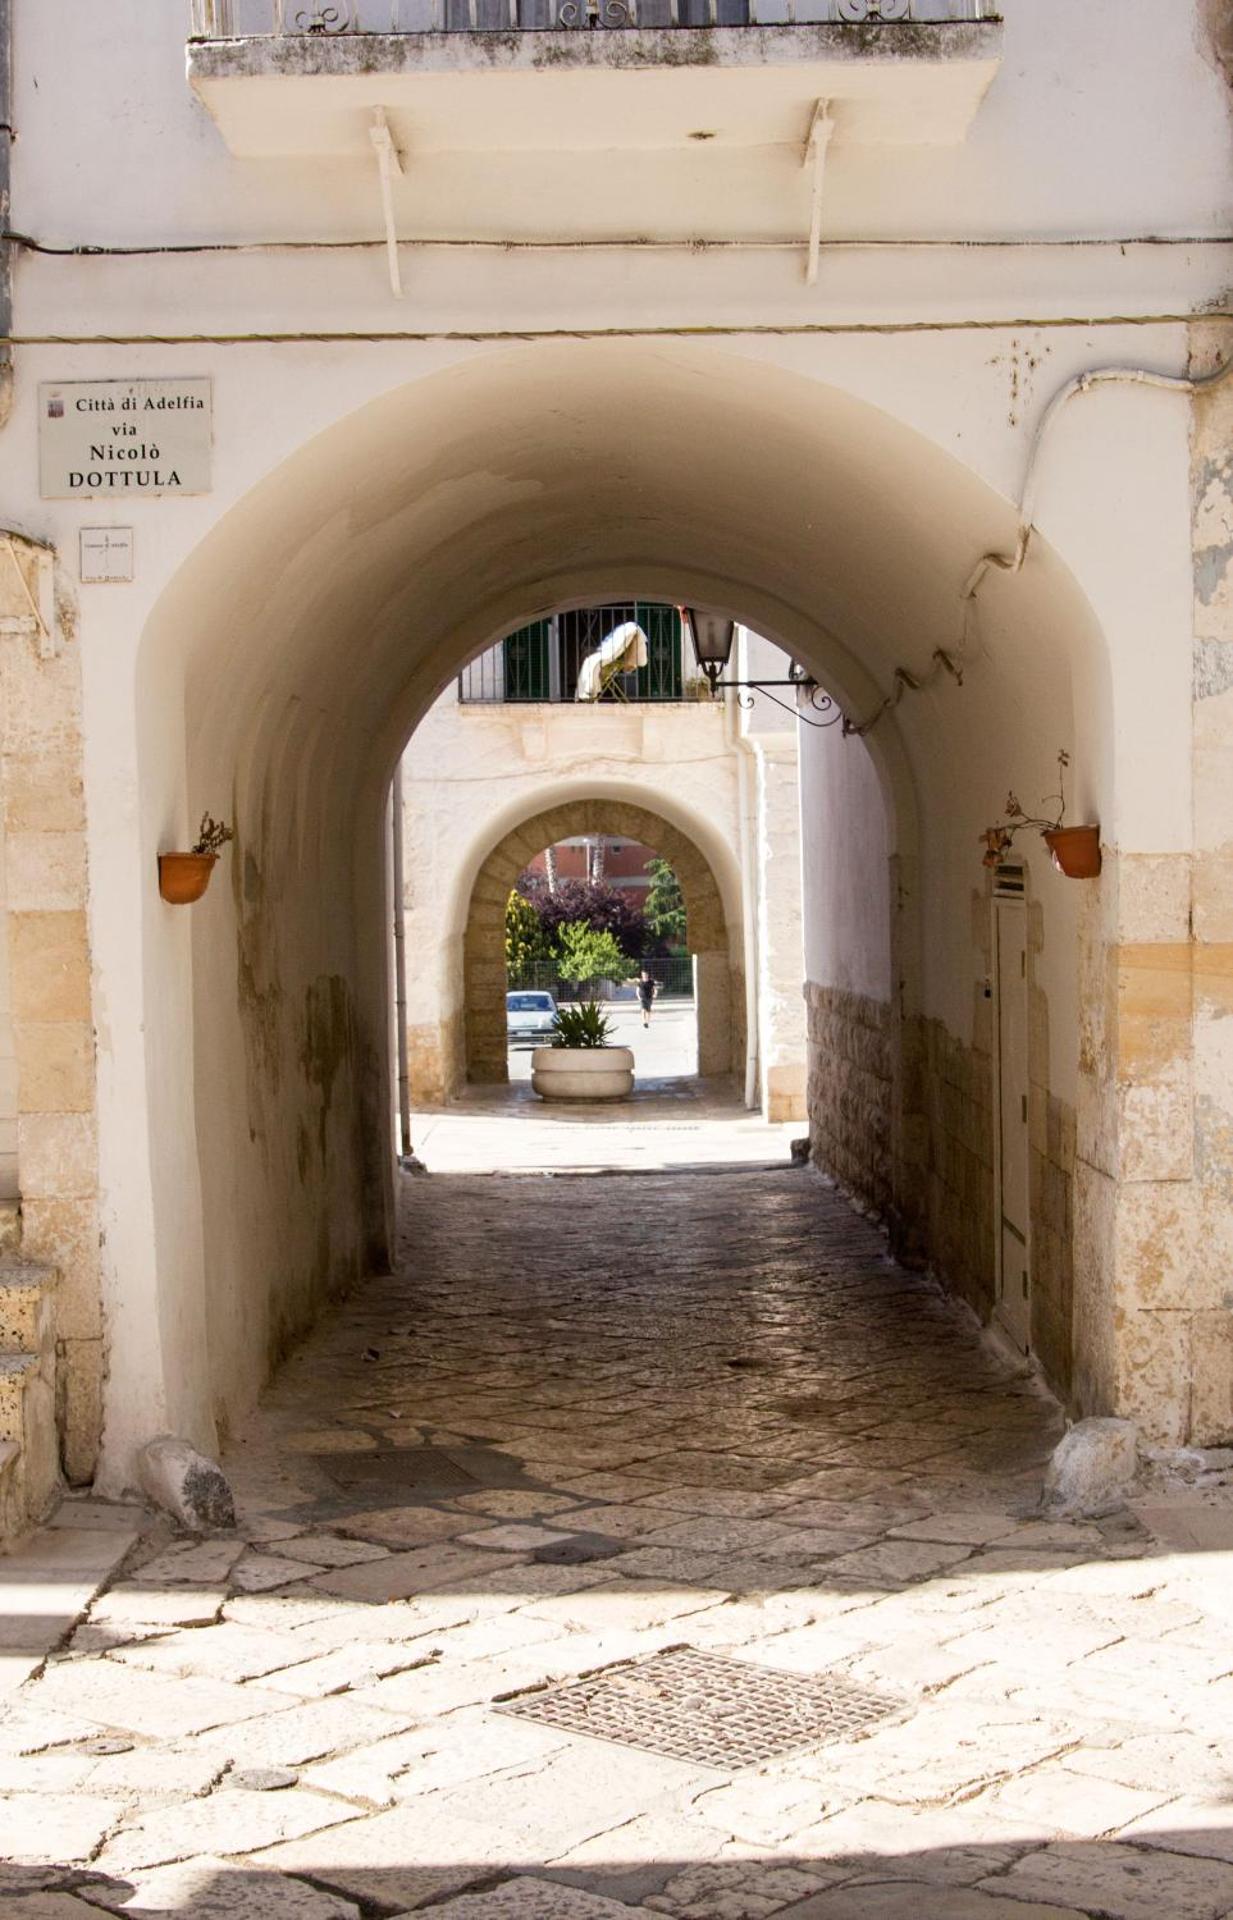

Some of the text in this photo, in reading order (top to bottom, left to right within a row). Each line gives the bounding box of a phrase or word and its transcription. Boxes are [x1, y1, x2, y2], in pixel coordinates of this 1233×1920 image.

[76, 395, 205, 412] Città di Adelfia
[112, 422, 137, 436] via
[90, 444, 160, 460] Nicolò
[69, 471, 182, 488] DOTTULA
